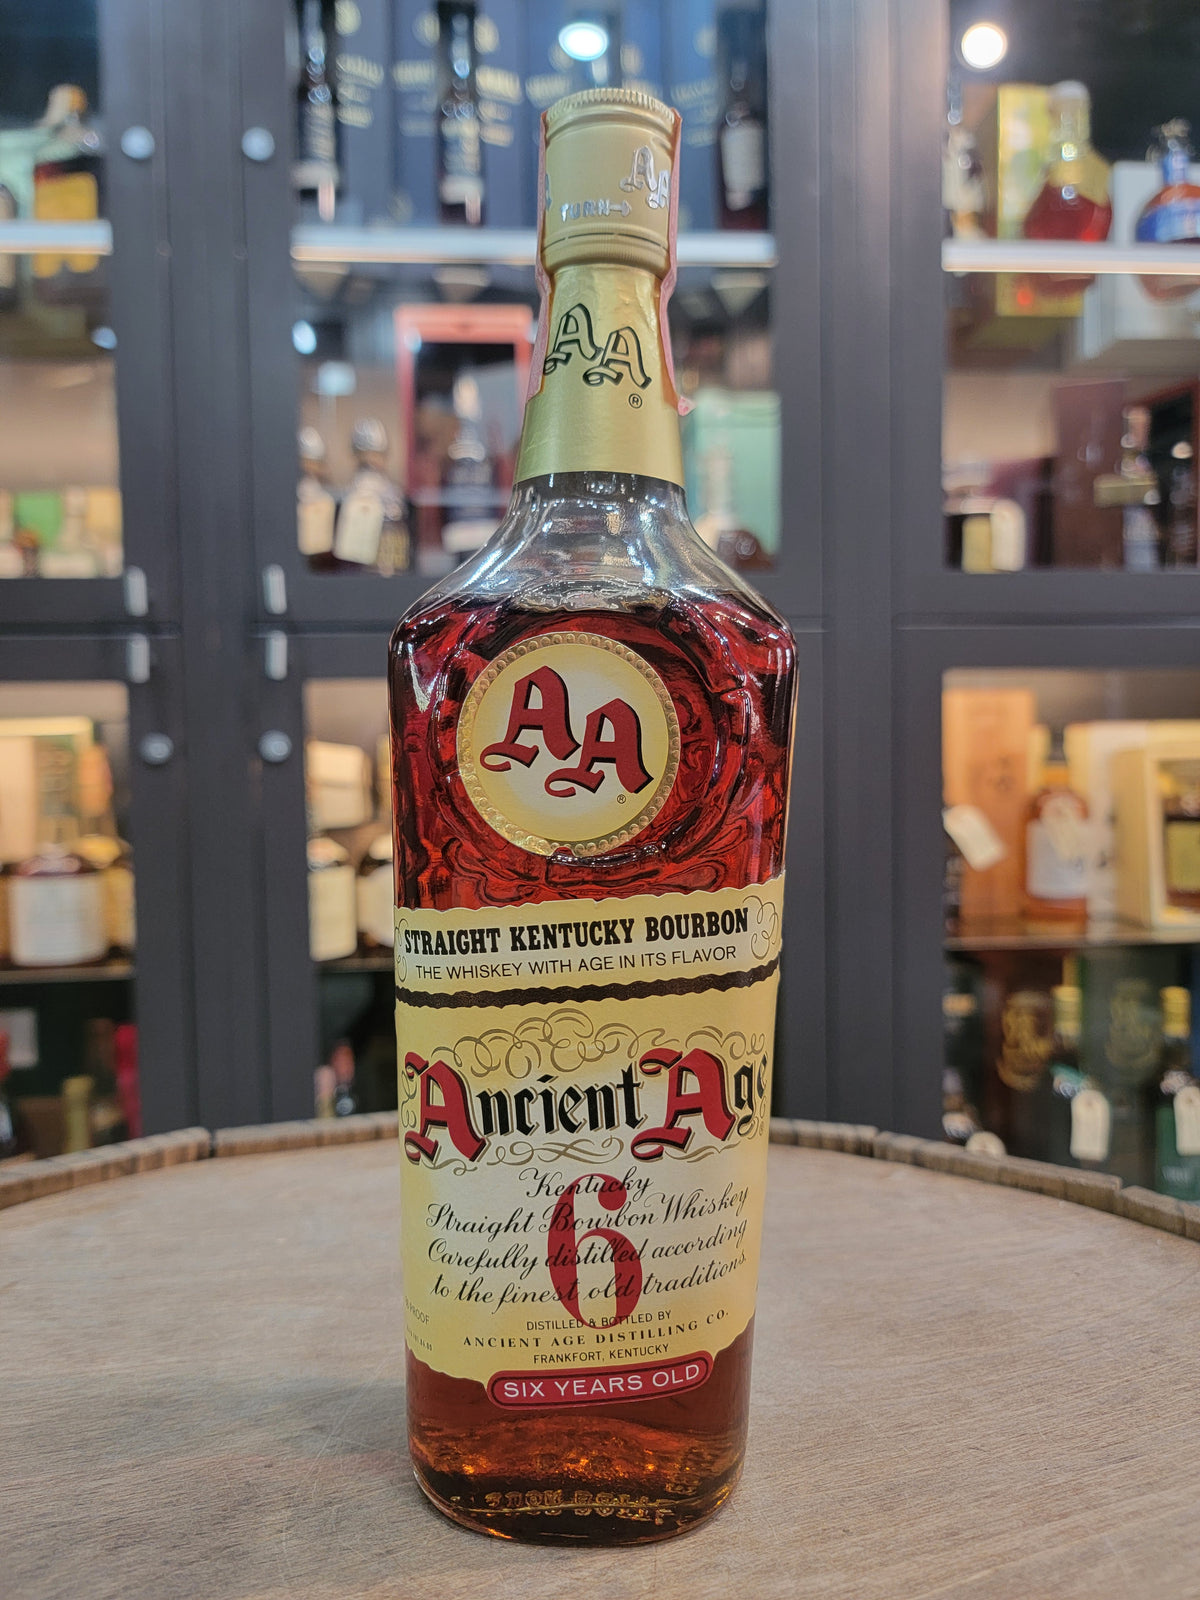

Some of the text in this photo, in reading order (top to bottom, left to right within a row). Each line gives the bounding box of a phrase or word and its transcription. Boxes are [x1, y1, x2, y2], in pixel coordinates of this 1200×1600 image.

[544, 303, 652, 390] AA
[480, 665, 654, 798] AA
[404, 907, 749, 956] STRAIGHT KENTUCKY BOURBON
[415, 945, 737, 980] THE WHISKEY WITH AGE IN ITS FLAVOR
[404, 1051, 647, 1163] Ancient
[518, 1165, 654, 1199] Kentucky
[425, 1182, 749, 1242] Straight Bourbon Whiskey
[427, 1217, 749, 1279] Carefully distilled according
[547, 1173, 643, 1330] 6
[430, 1273, 451, 1299] to
[453, 1273, 500, 1304] the
[491, 1282, 580, 1315] finest
[587, 1269, 640, 1299] old
[463, 1309, 729, 1349] ANCIENT AGE DISTILLING CO.
[526, 1309, 672, 1331] DISTILLED & BOTTLED BY
[533, 1343, 670, 1365] FRANKFORT, KENTUCKY
[503, 1364, 701, 1398] SIX YEARS OLD
